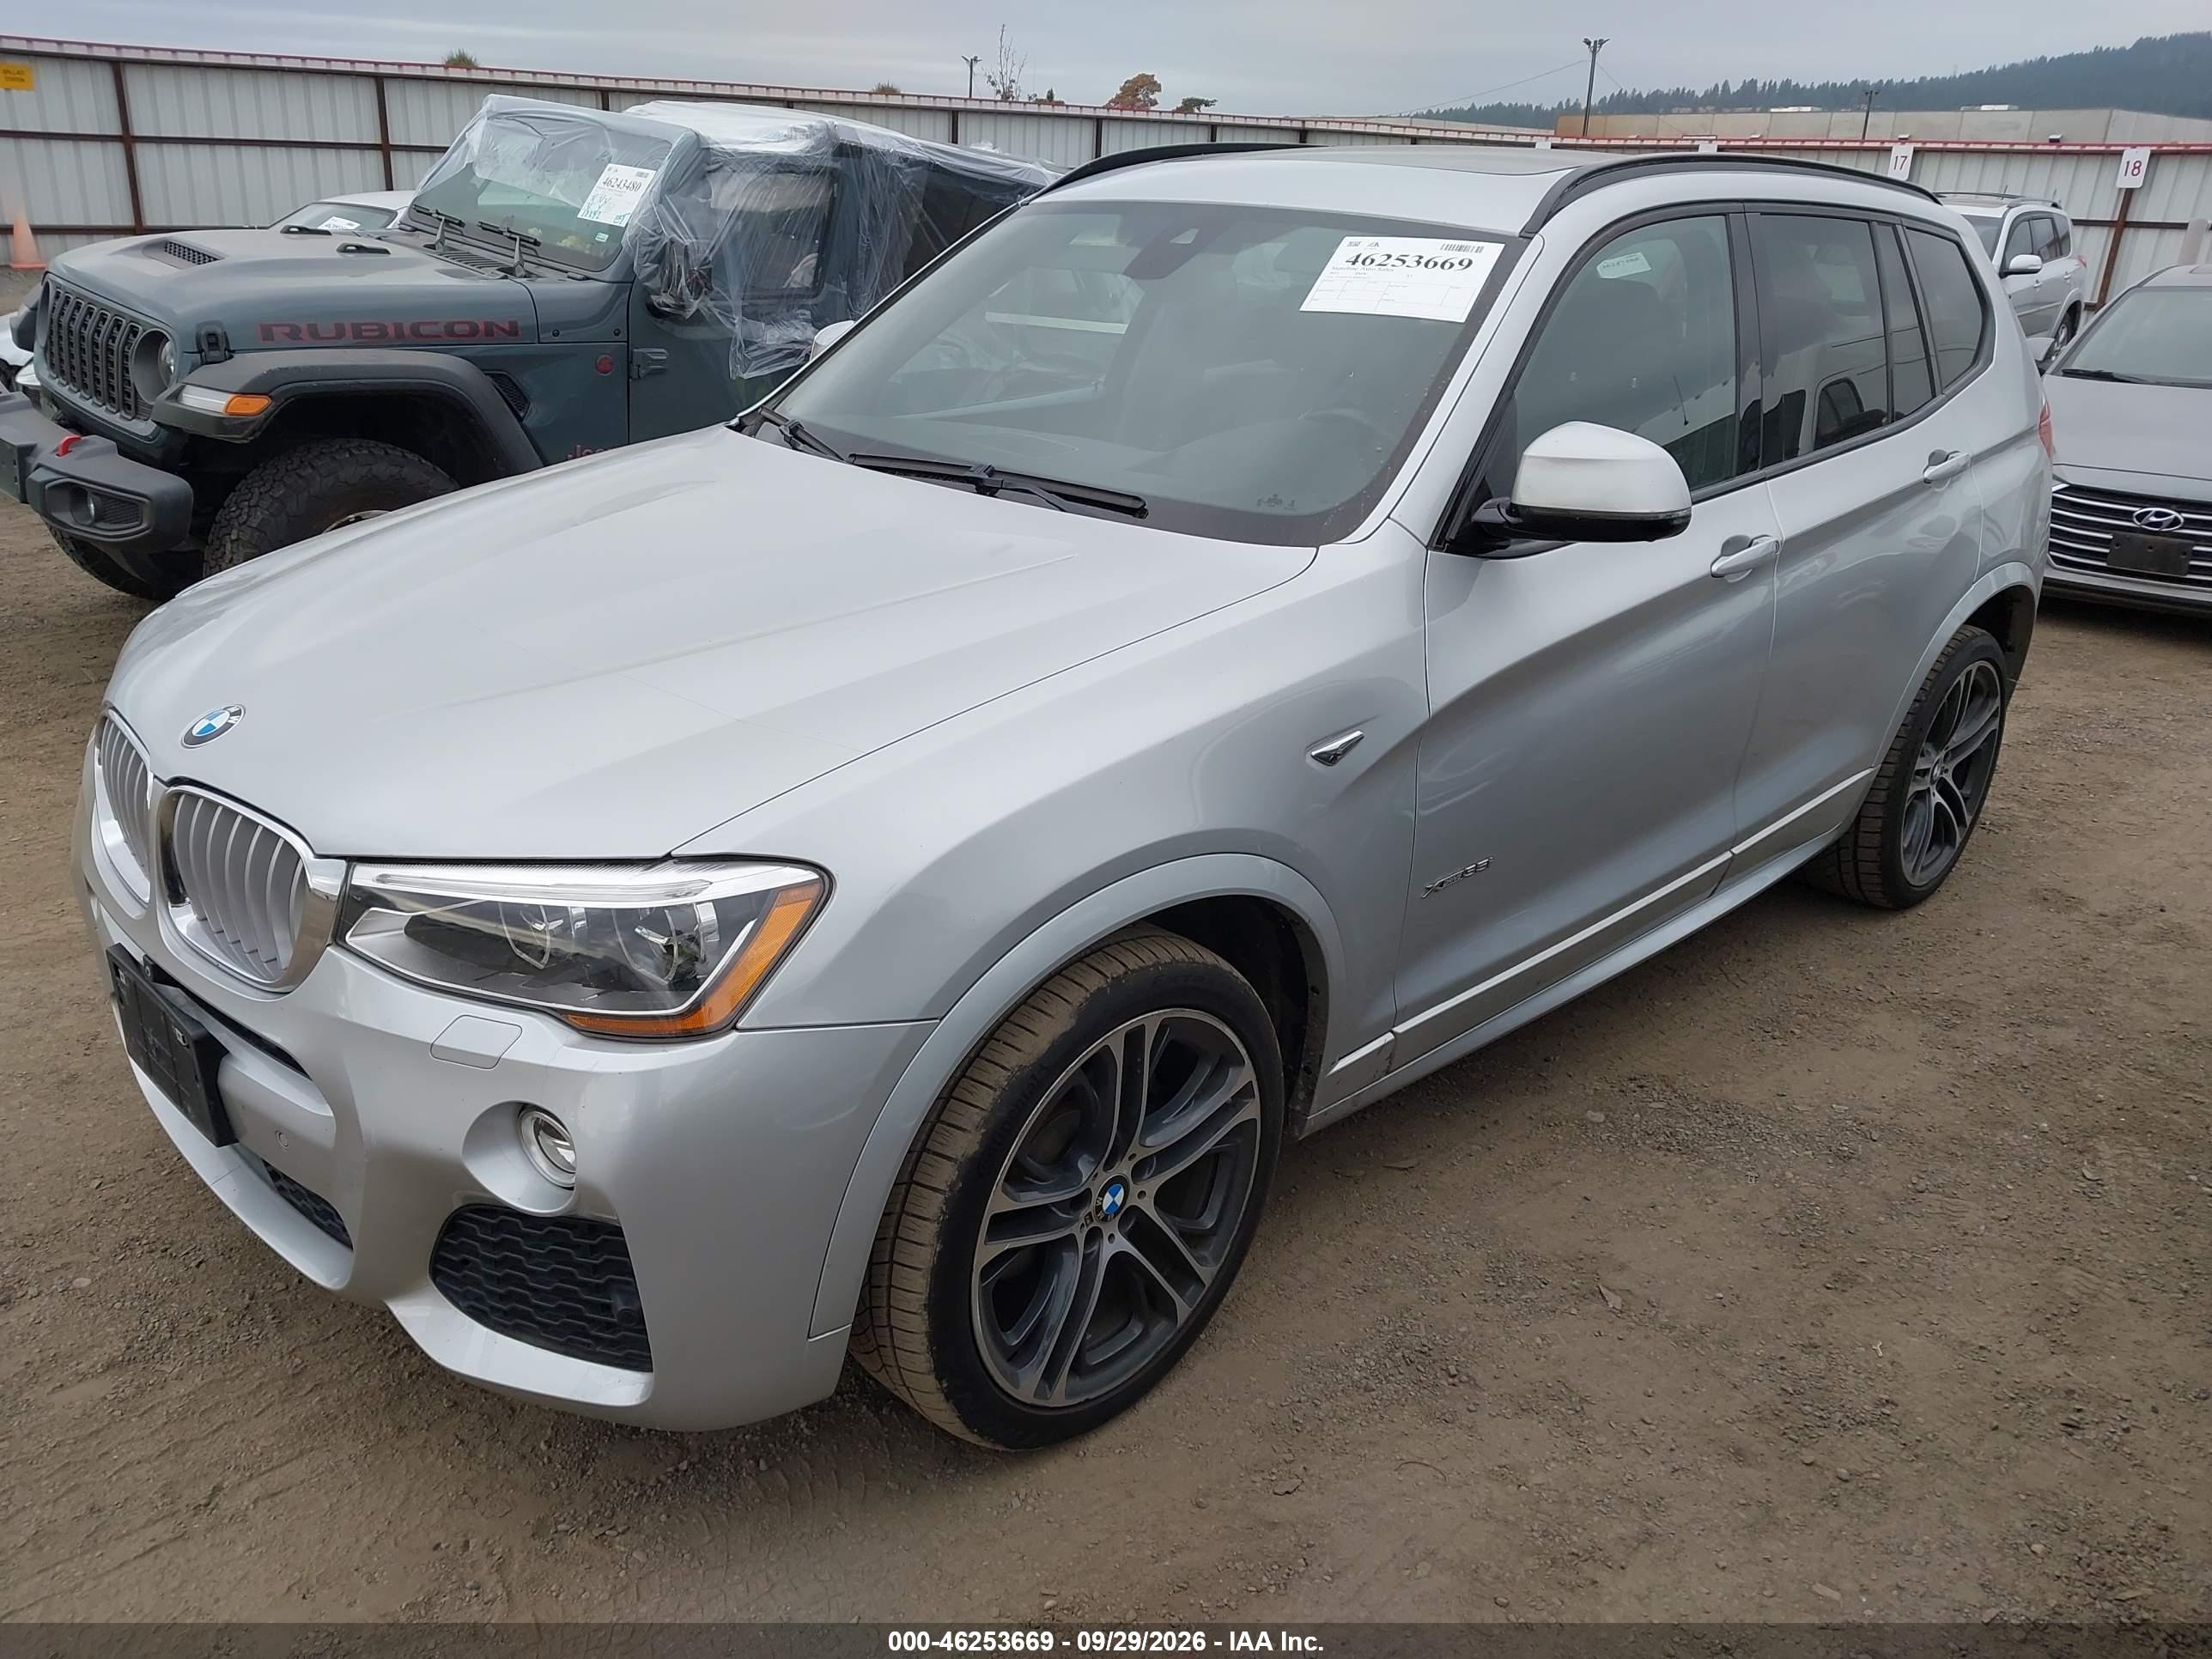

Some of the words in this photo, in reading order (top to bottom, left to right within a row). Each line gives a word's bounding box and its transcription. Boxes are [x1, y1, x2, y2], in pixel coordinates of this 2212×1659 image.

[1893, 155, 1907, 170] 17
[2124, 161, 2142, 177] 18
[603, 177, 642, 193] 46243480
[1346, 252, 1474, 271] 46253669
[258, 319, 520, 342] RUBICON
